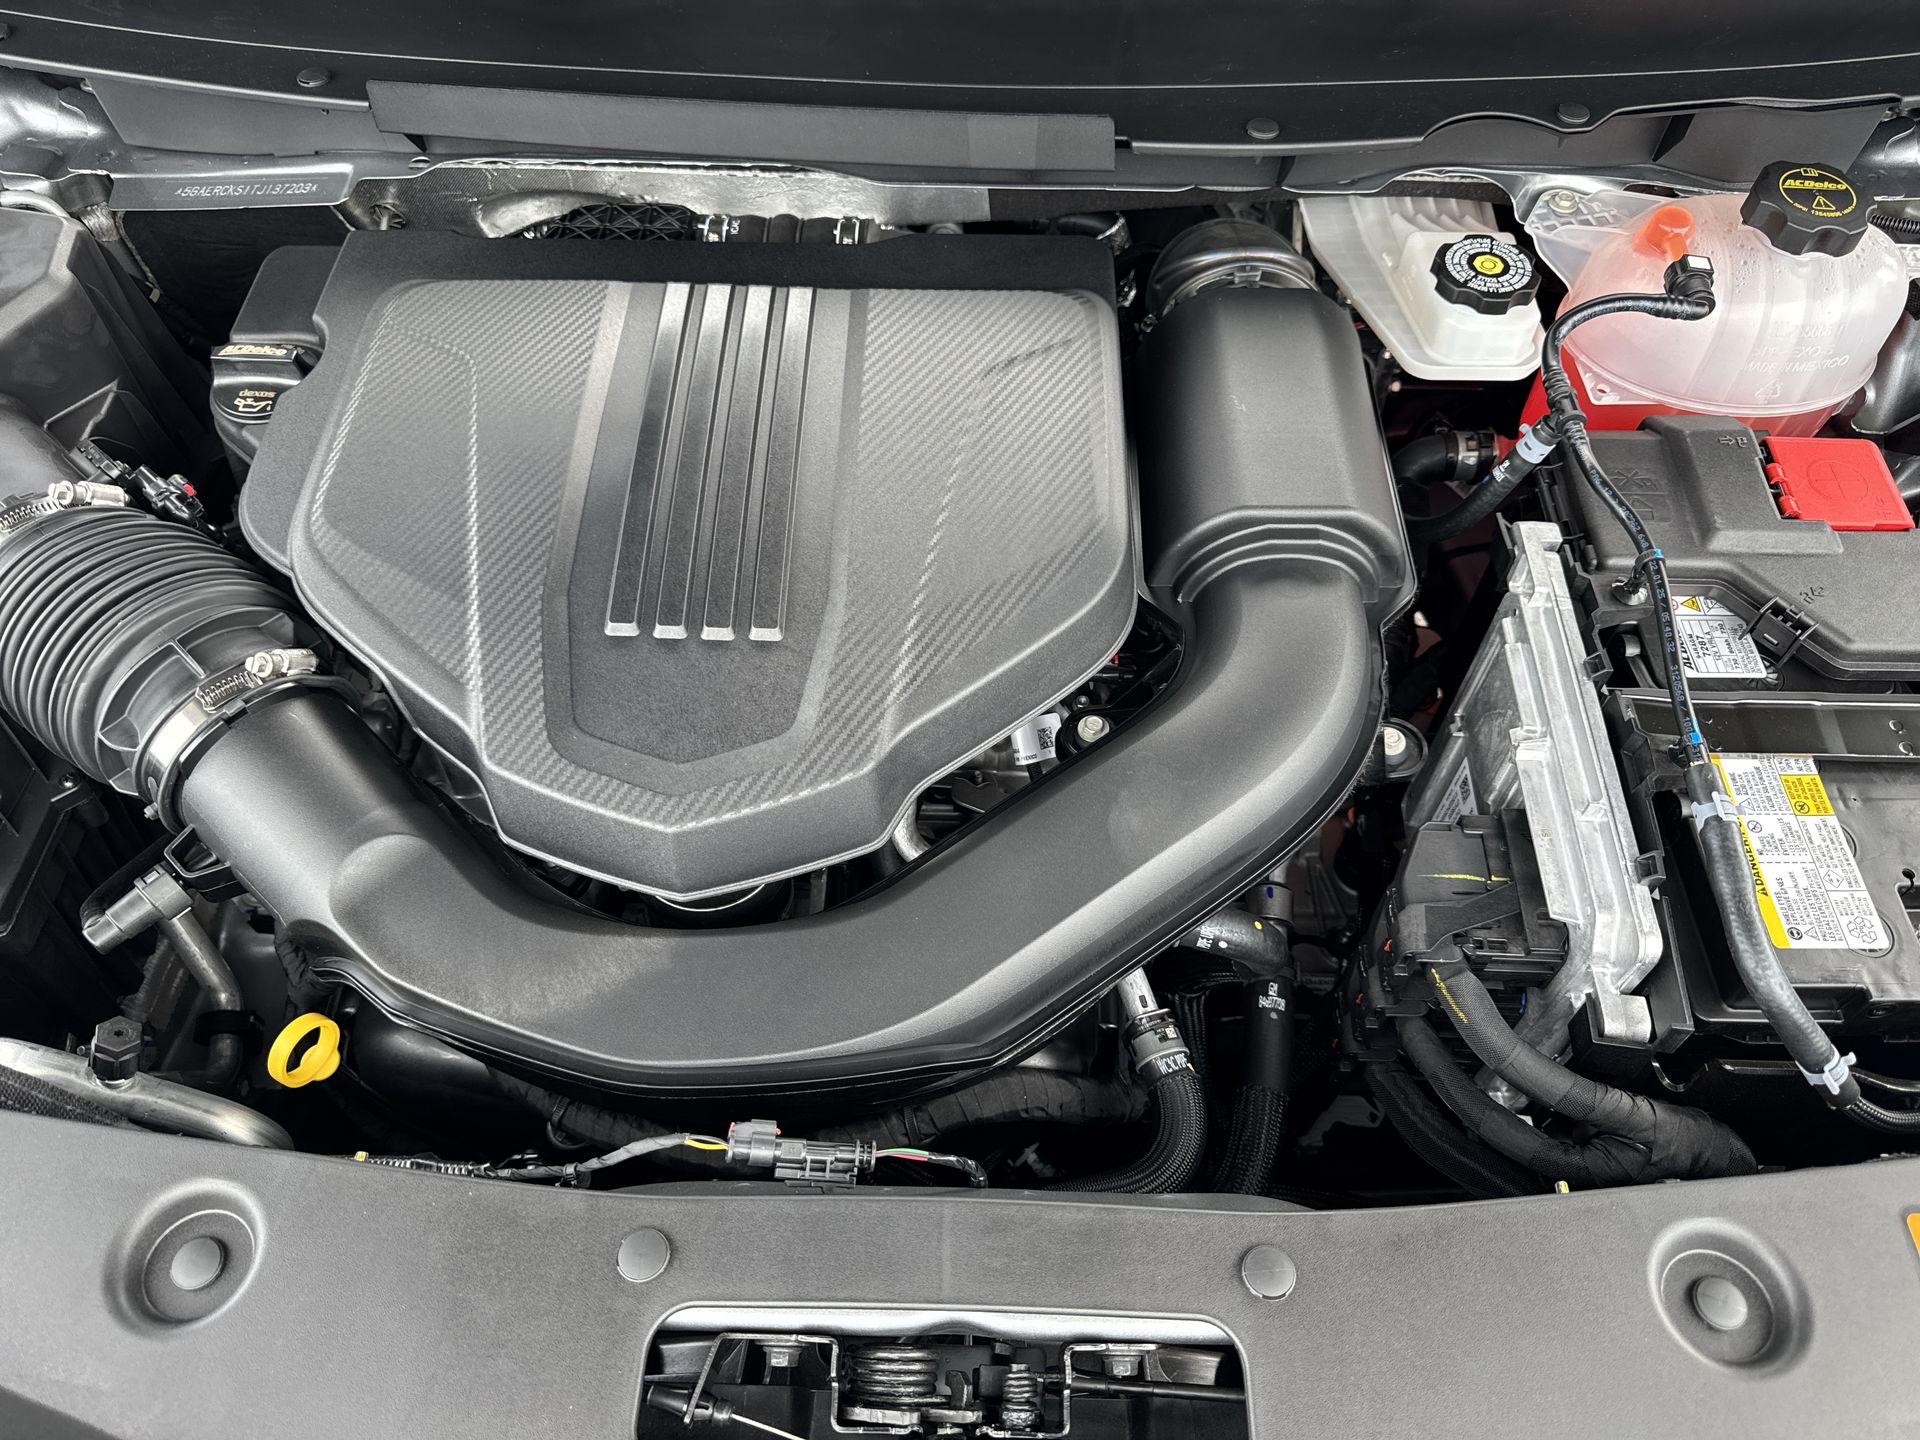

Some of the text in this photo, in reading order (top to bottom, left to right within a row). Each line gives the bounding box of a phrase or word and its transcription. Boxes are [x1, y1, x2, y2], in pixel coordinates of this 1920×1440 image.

[1783, 179, 1847, 190] ACDelco
[239, 389, 277, 398] dexos
[1695, 634, 1711, 657] 7287
